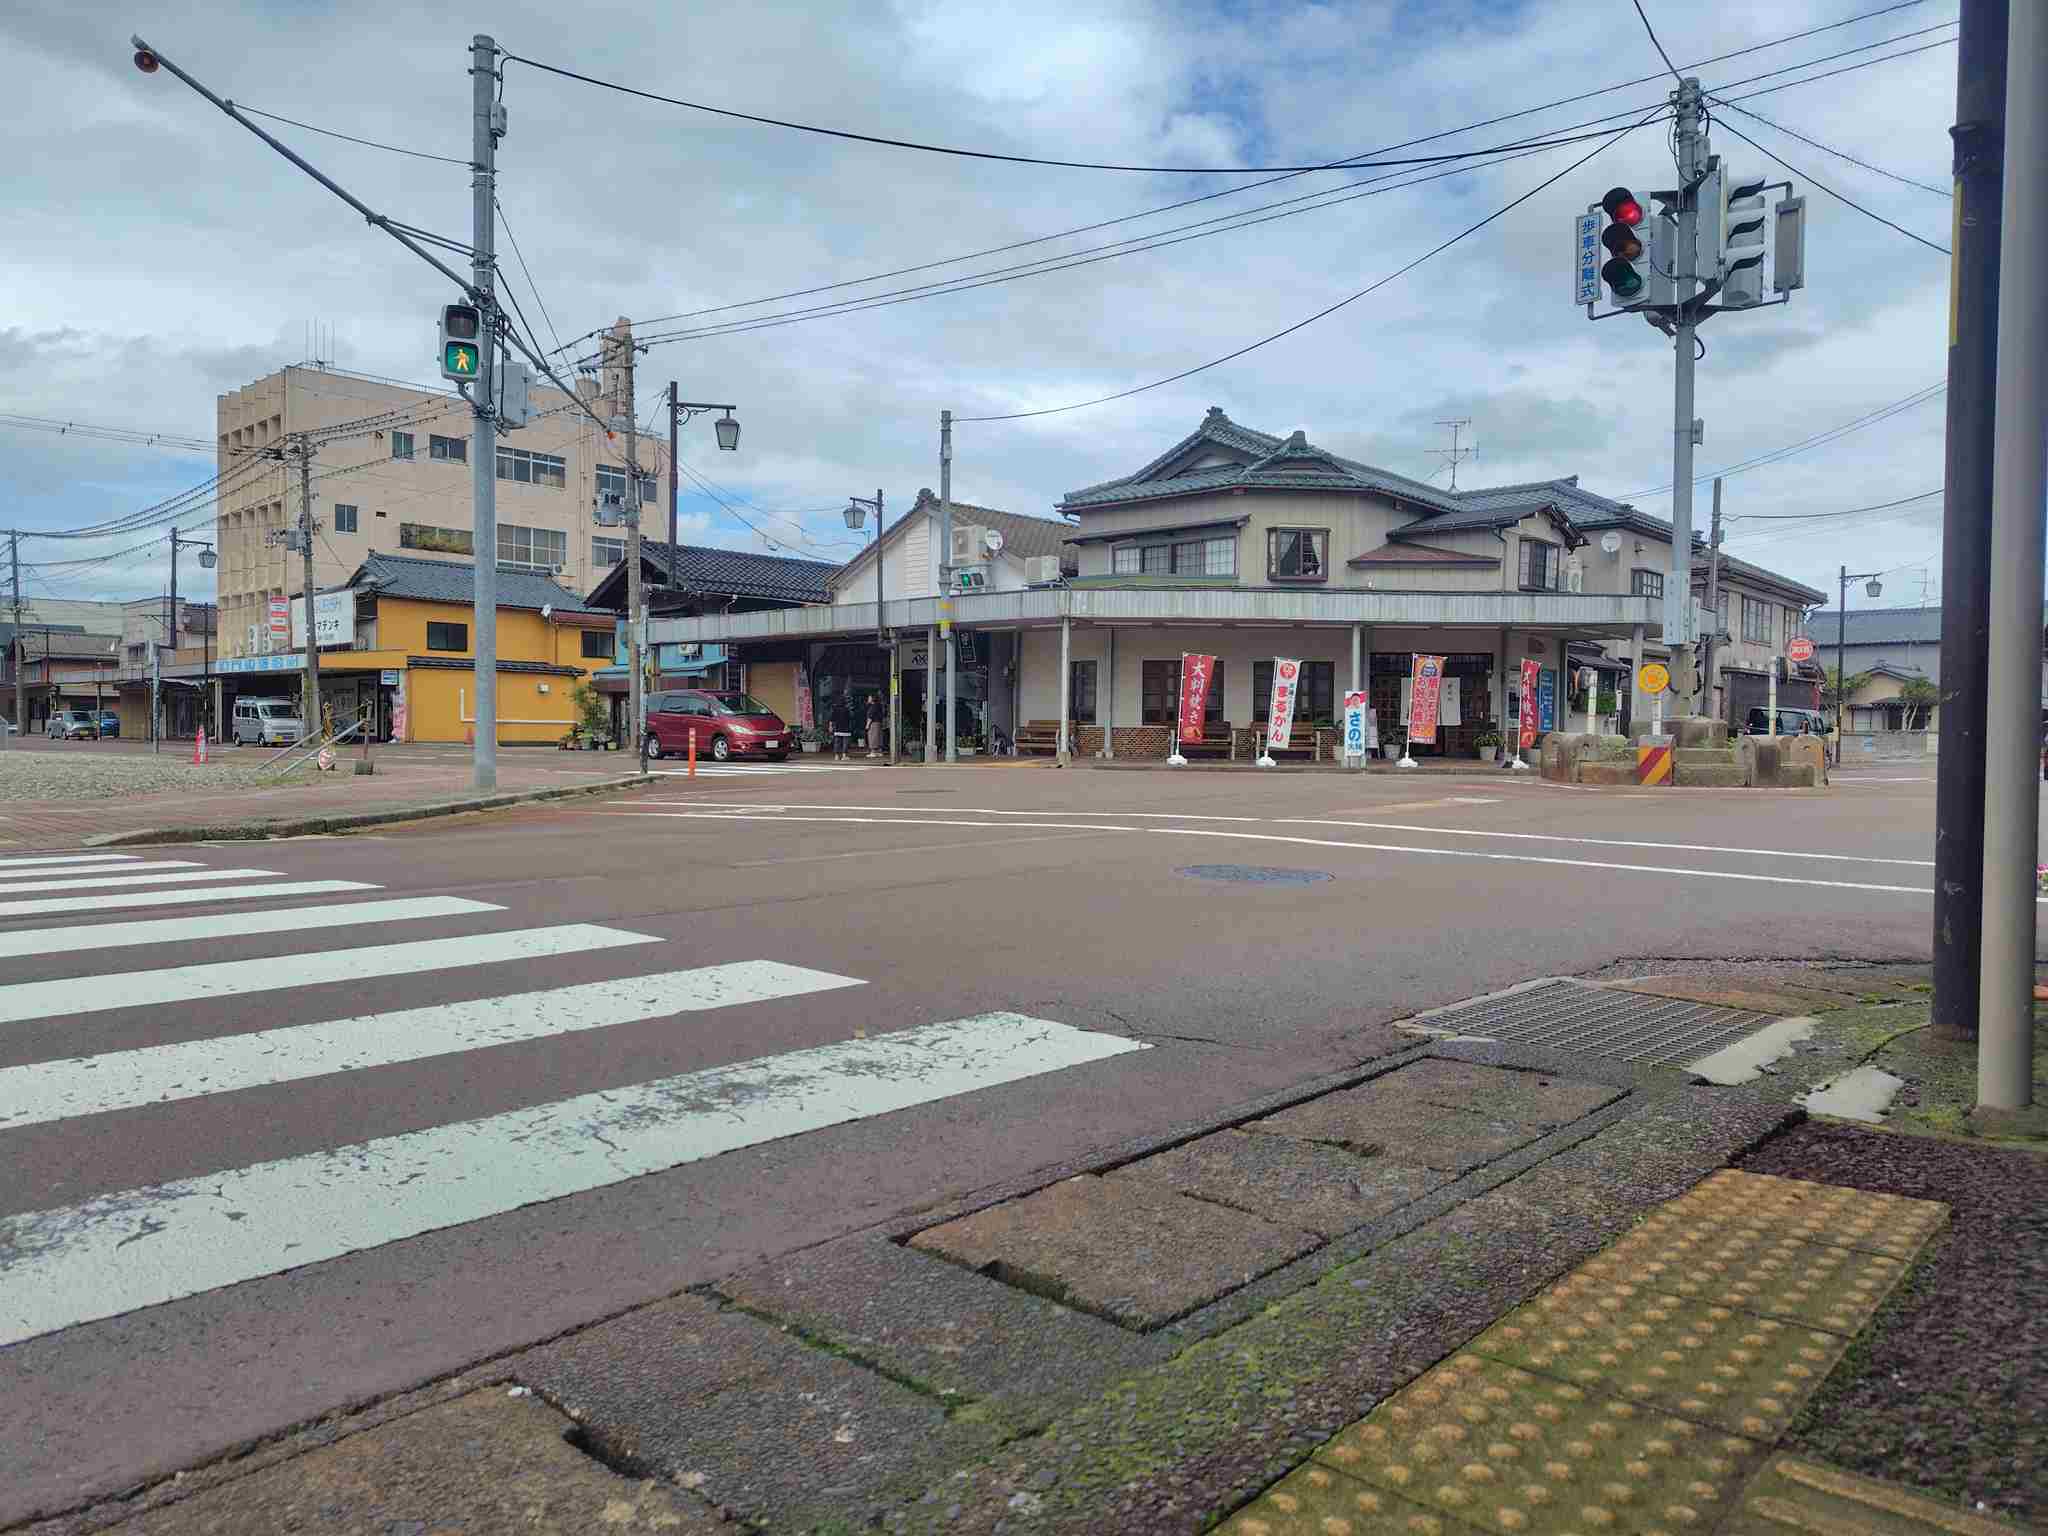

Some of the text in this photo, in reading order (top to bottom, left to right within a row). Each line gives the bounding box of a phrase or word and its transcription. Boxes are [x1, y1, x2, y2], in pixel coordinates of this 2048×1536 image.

[1583, 218, 1595, 297] 歩車分離式
